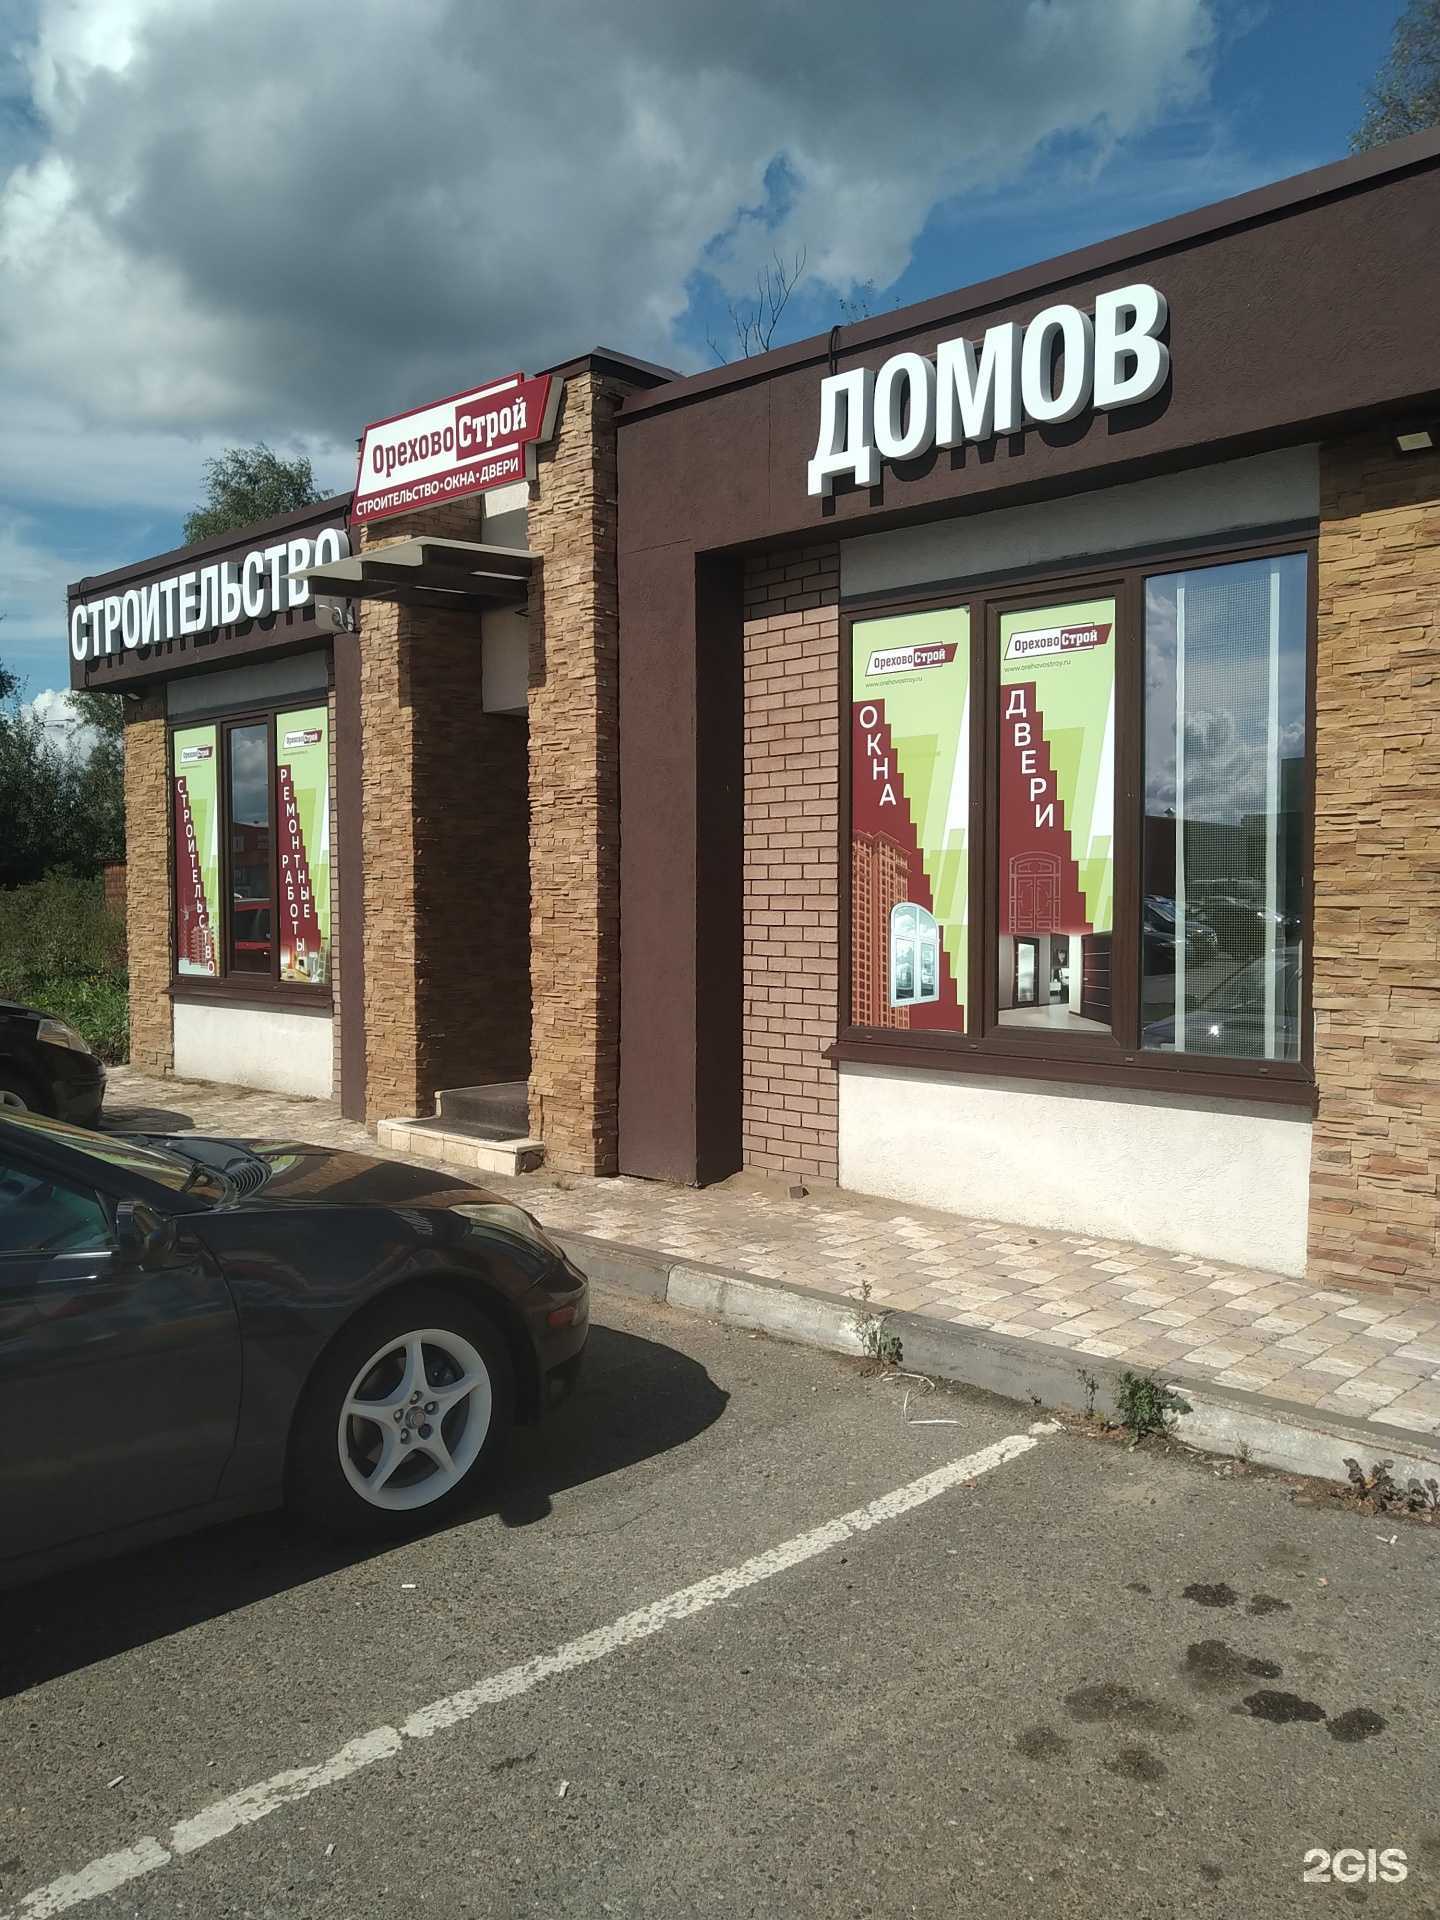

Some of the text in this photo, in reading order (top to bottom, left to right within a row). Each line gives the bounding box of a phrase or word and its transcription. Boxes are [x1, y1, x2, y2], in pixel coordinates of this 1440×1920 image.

[372, 396, 527, 478] ОреховоСтрой
[808, 283, 1169, 496] ДОМОВ
[874, 648, 946, 670] ОреховоСтрой
[1014, 629, 1098, 653] ОреховоСтрой
[859, 705, 896, 807] ОКНА
[1005, 689, 1054, 828] ДВЕРИ
[177, 779, 215, 975] СТРОИТЕЛЬСТВО
[280, 768, 310, 919] РЕМОНТНЫЕ
[282, 854, 305, 952] РАБОТЫ
